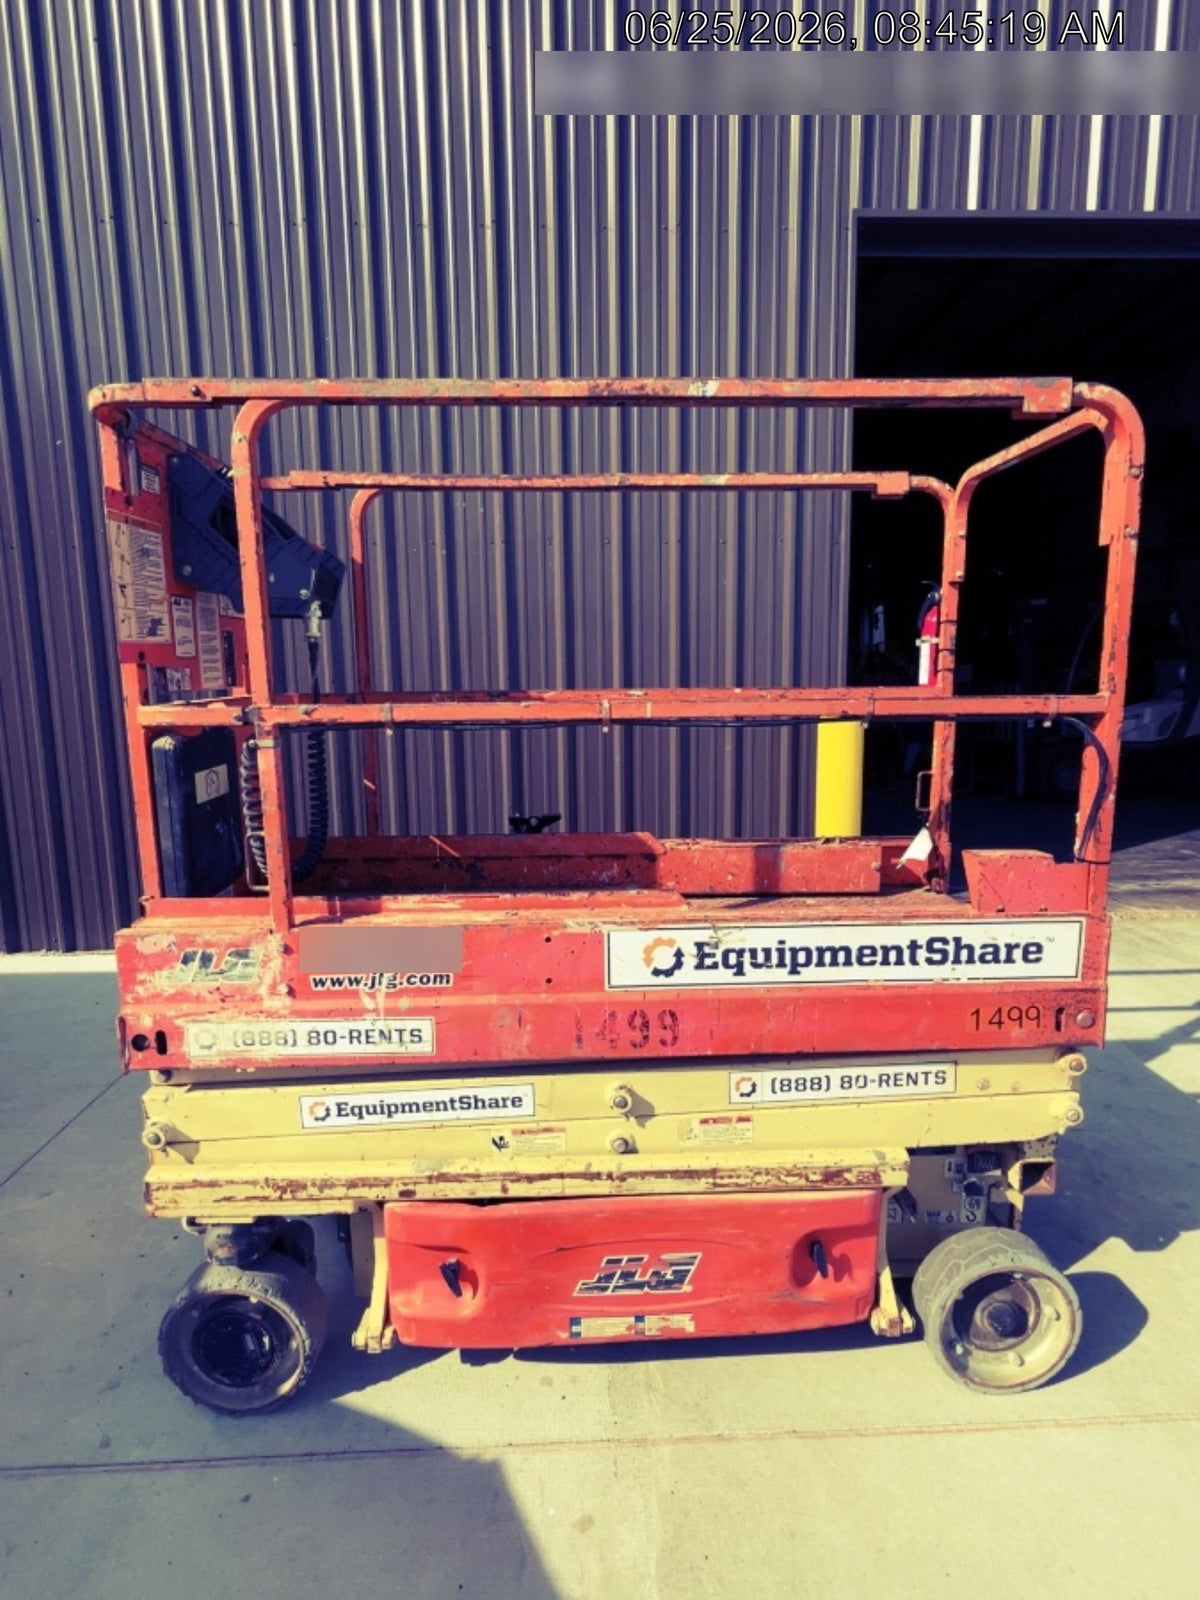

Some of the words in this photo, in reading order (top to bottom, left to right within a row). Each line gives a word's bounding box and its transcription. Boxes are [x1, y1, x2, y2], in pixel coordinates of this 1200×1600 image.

[694, 936, 1044, 976] EquipmentShare
[312, 972, 451, 990] www.jlg.com
[970, 1005, 1041, 1031] 1499
[307, 1028, 422, 1046] 80-RENTS
[770, 1074, 831, 1094] (888)
[840, 1069, 947, 1091] 80-RENTS
[335, 1093, 523, 1119] EquipmentShare
[572, 1252, 702, 1296] JLG
